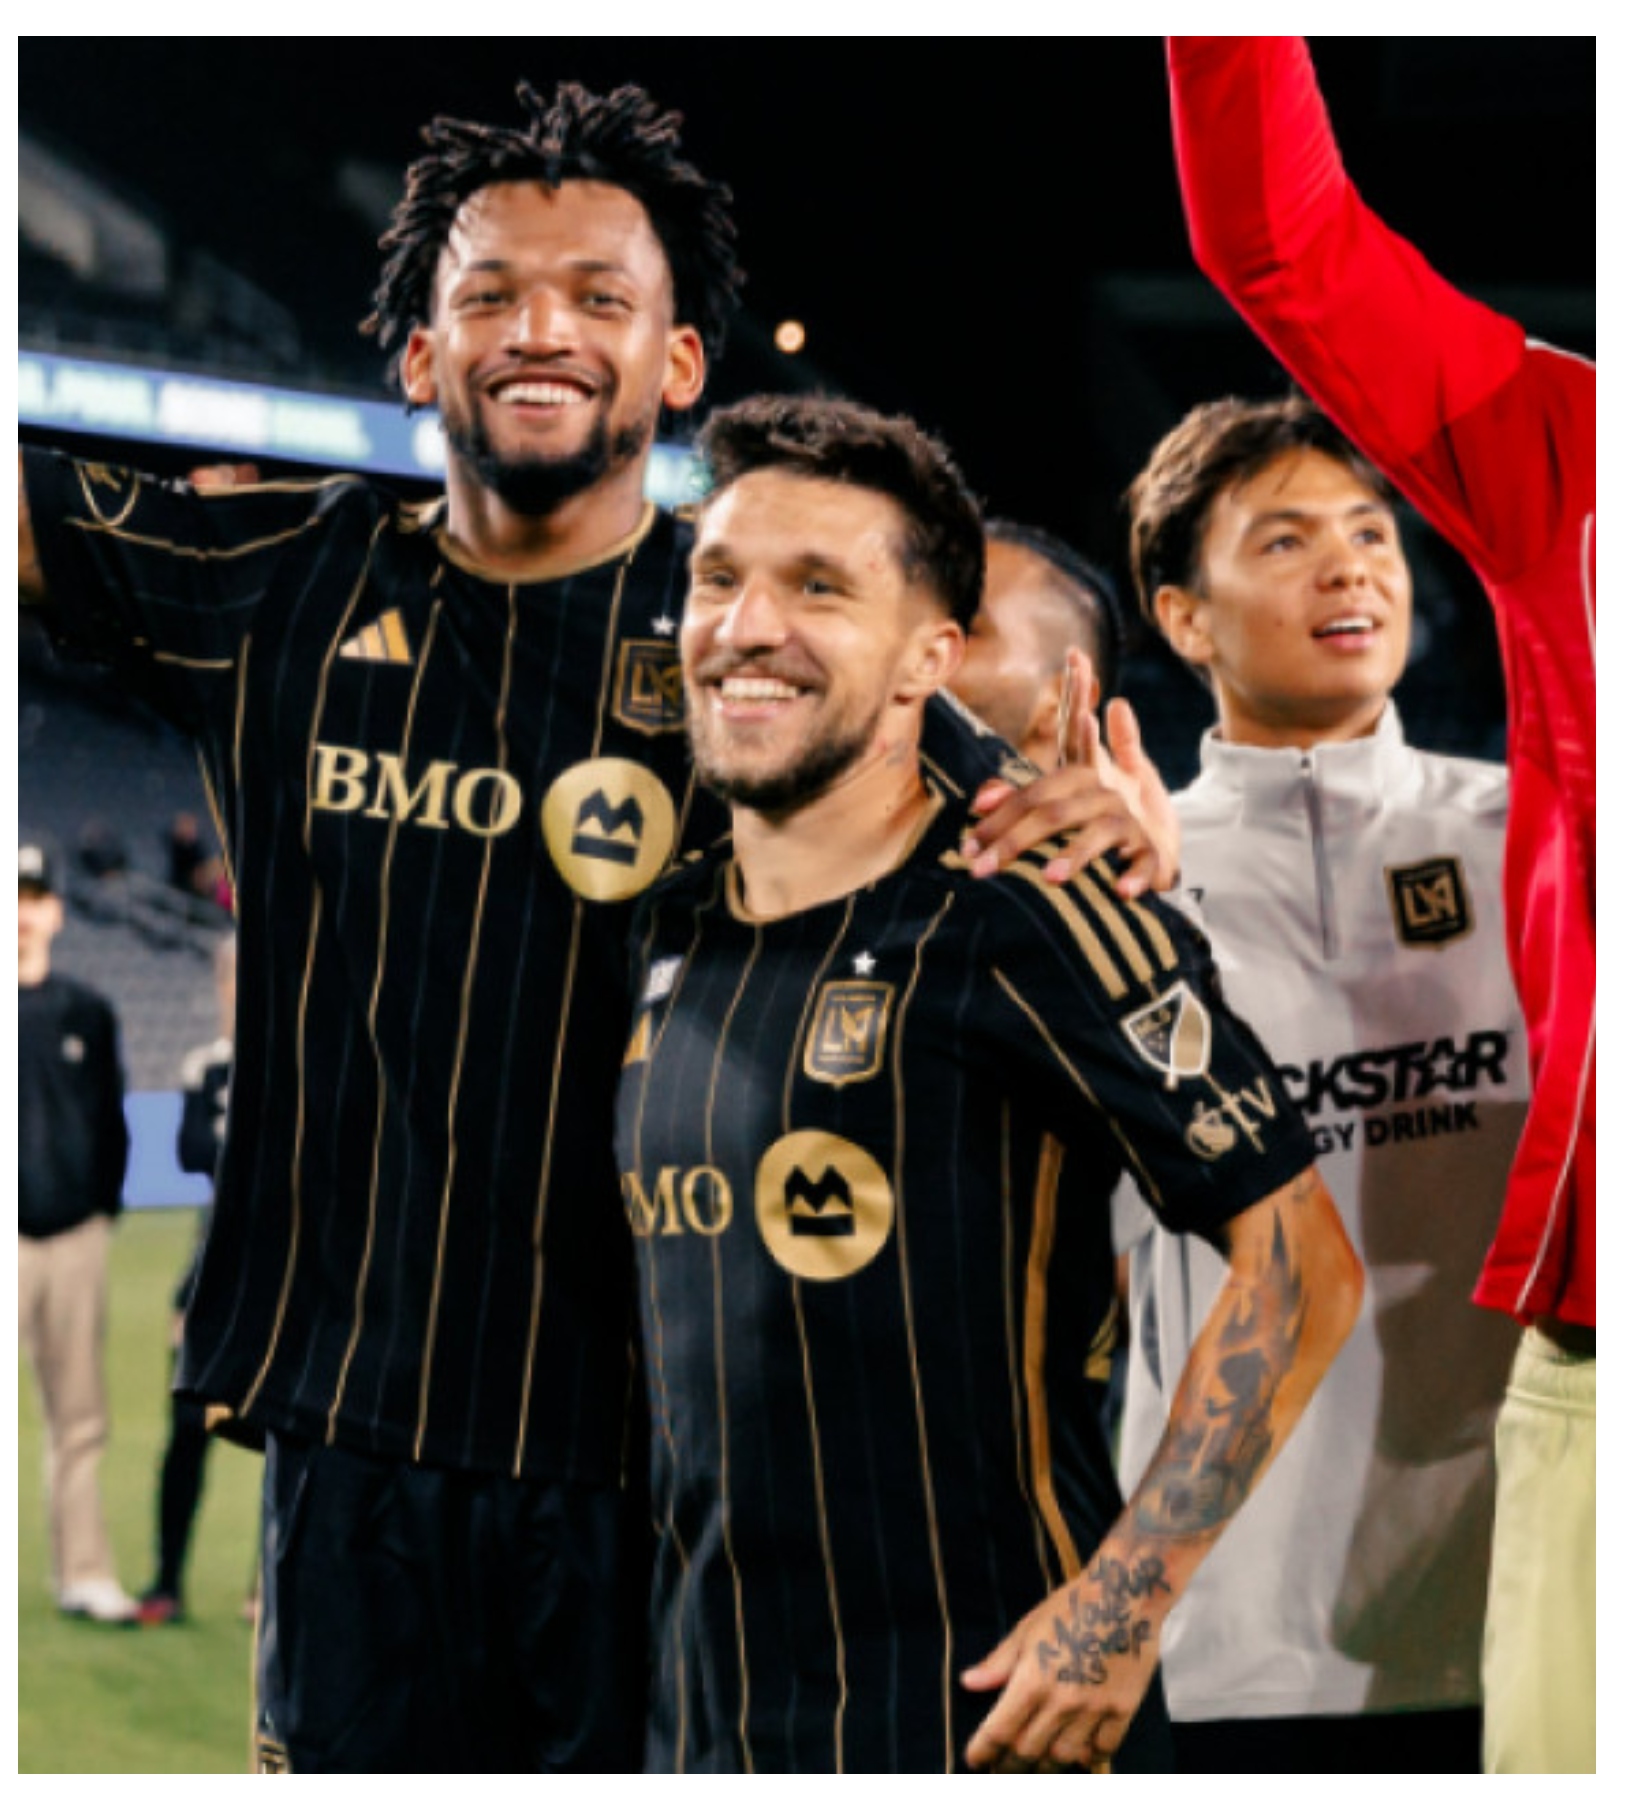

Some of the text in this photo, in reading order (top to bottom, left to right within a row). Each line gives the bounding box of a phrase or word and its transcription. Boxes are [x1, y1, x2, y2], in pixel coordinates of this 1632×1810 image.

[310, 741, 524, 838] BMO
[1221, 1076, 1277, 1134] tv
[1274, 1030, 1509, 1116] CKSTAR
[1364, 1101, 1479, 1147] DRINK
[620, 1164, 734, 1237] MO
